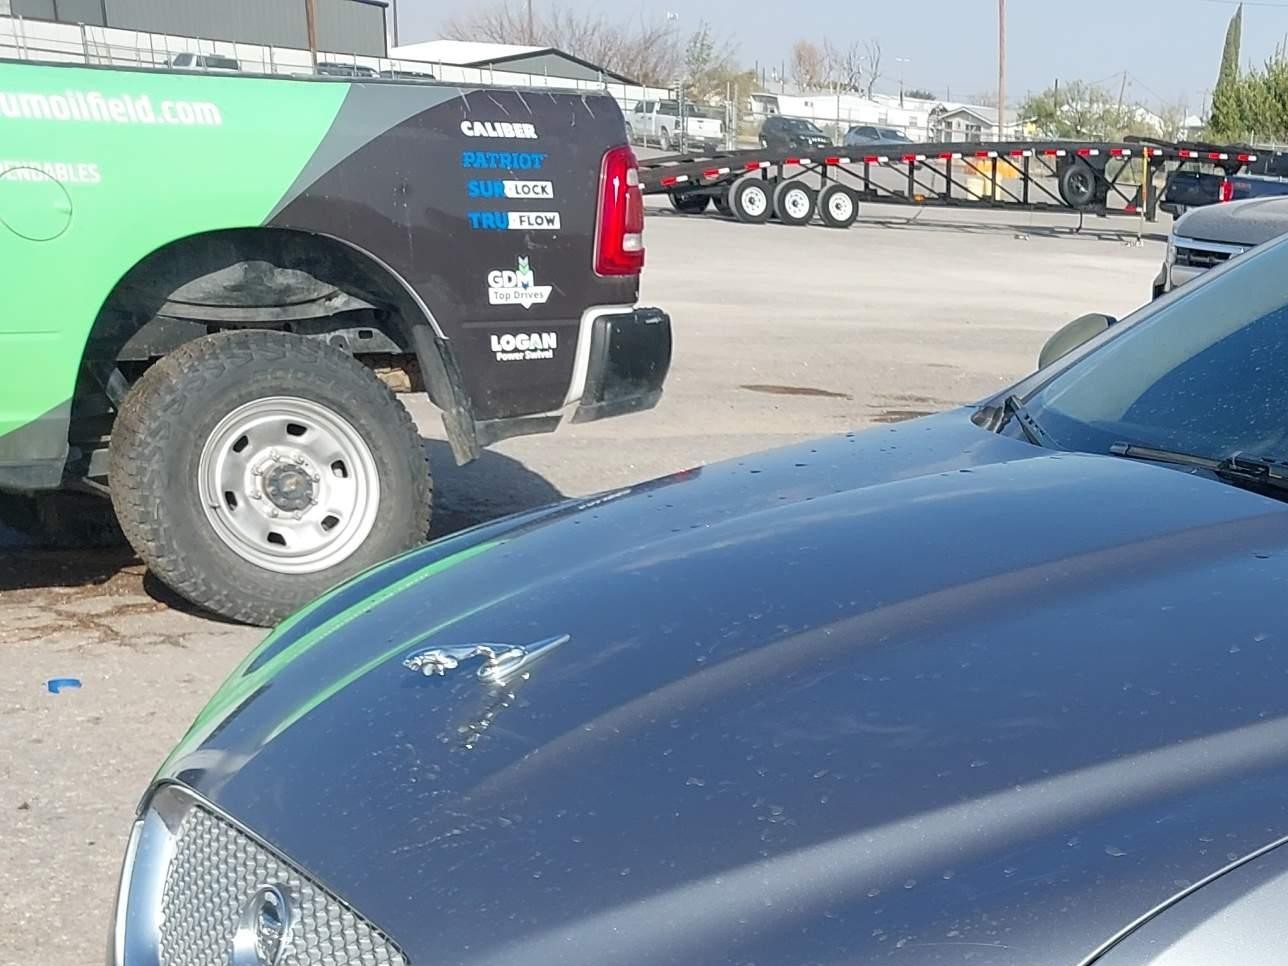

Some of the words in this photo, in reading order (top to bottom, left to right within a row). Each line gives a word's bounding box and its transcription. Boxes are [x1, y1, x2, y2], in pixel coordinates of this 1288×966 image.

[0, 91, 222, 125] umoilfield.com
[460, 120, 538, 139] CALIBER
[463, 151, 544, 169] PATRIOT
[514, 184, 549, 195] LOCK
[467, 211, 509, 229] TRU
[519, 215, 555, 226] FLOW
[487, 269, 534, 289] GDM
[494, 291, 511, 302] Top
[513, 290, 544, 299] Drives
[490, 332, 557, 352] LOGAN
[496, 352, 524, 361] Power
[524, 349, 554, 360] Swivel
